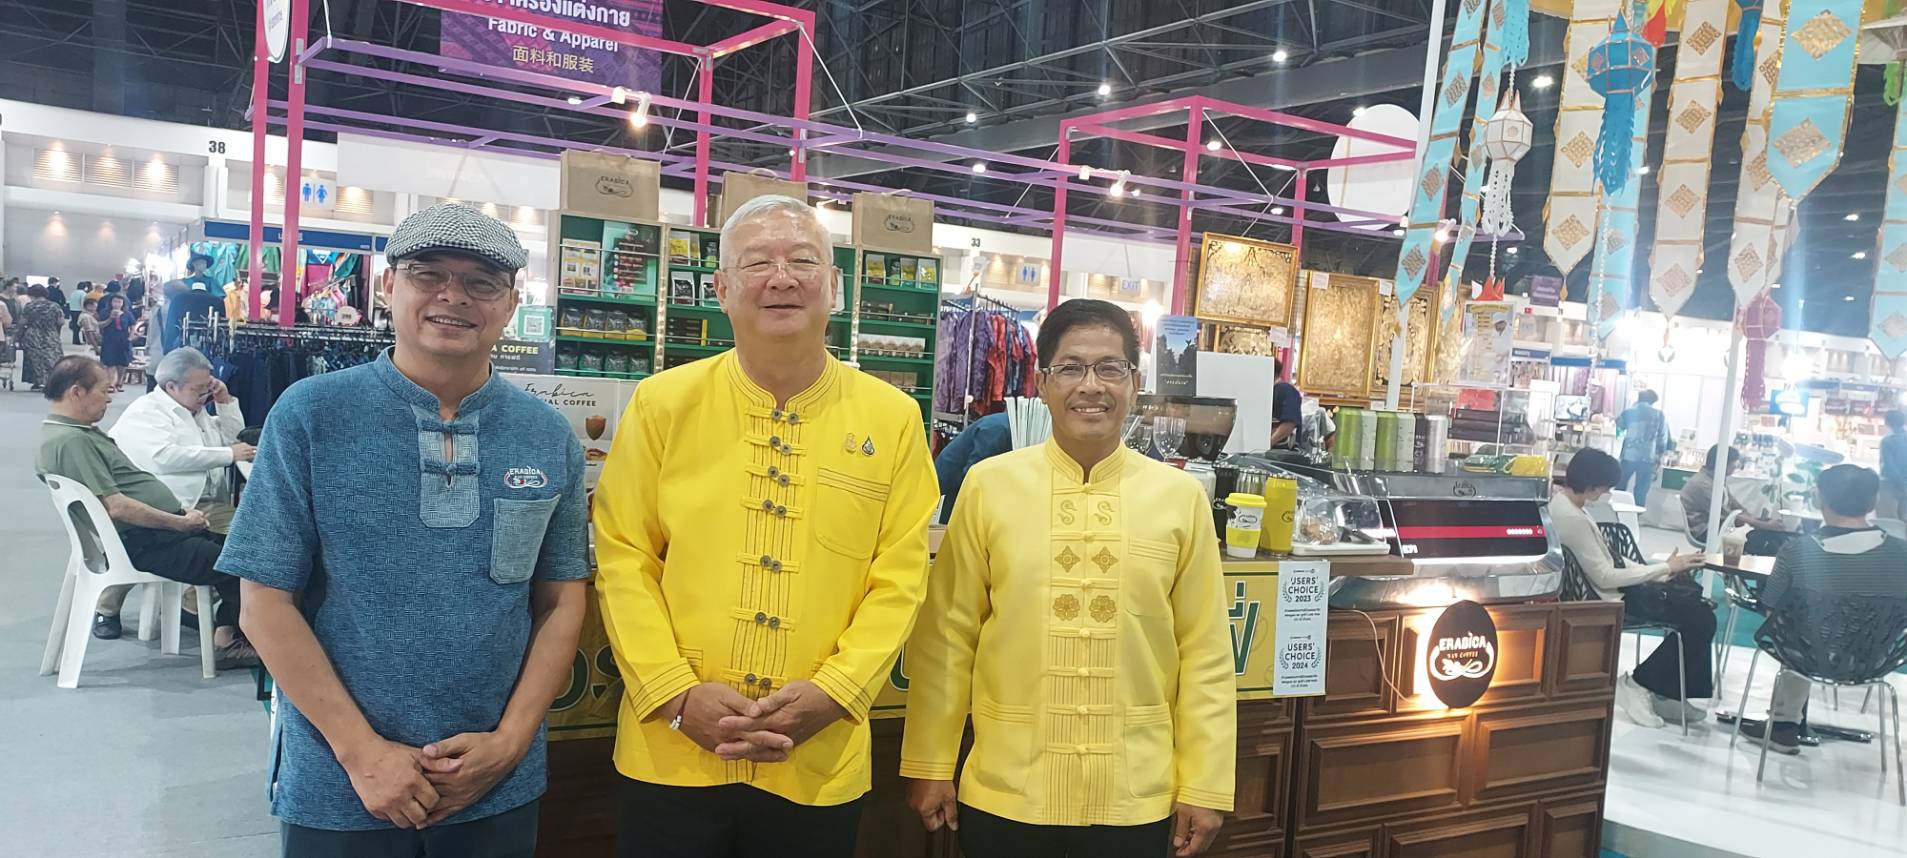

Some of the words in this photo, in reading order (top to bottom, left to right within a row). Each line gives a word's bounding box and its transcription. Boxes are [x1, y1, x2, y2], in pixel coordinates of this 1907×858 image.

[488, 18, 537, 37] Fabric
[543, 29, 555, 41] &
[560, 31, 618, 52] Apparel
[512, 45, 594, 73] 面料和服装
[208, 140, 226, 154] 38
[971, 237, 981, 247] 33
[1122, 279, 1140, 289] EXIT
[501, 344, 539, 354] COFFEE
[1287, 585, 1319, 594] CHOICE
[1295, 595, 1312, 603] 2023
[1284, 651, 1316, 660] CHOICE
